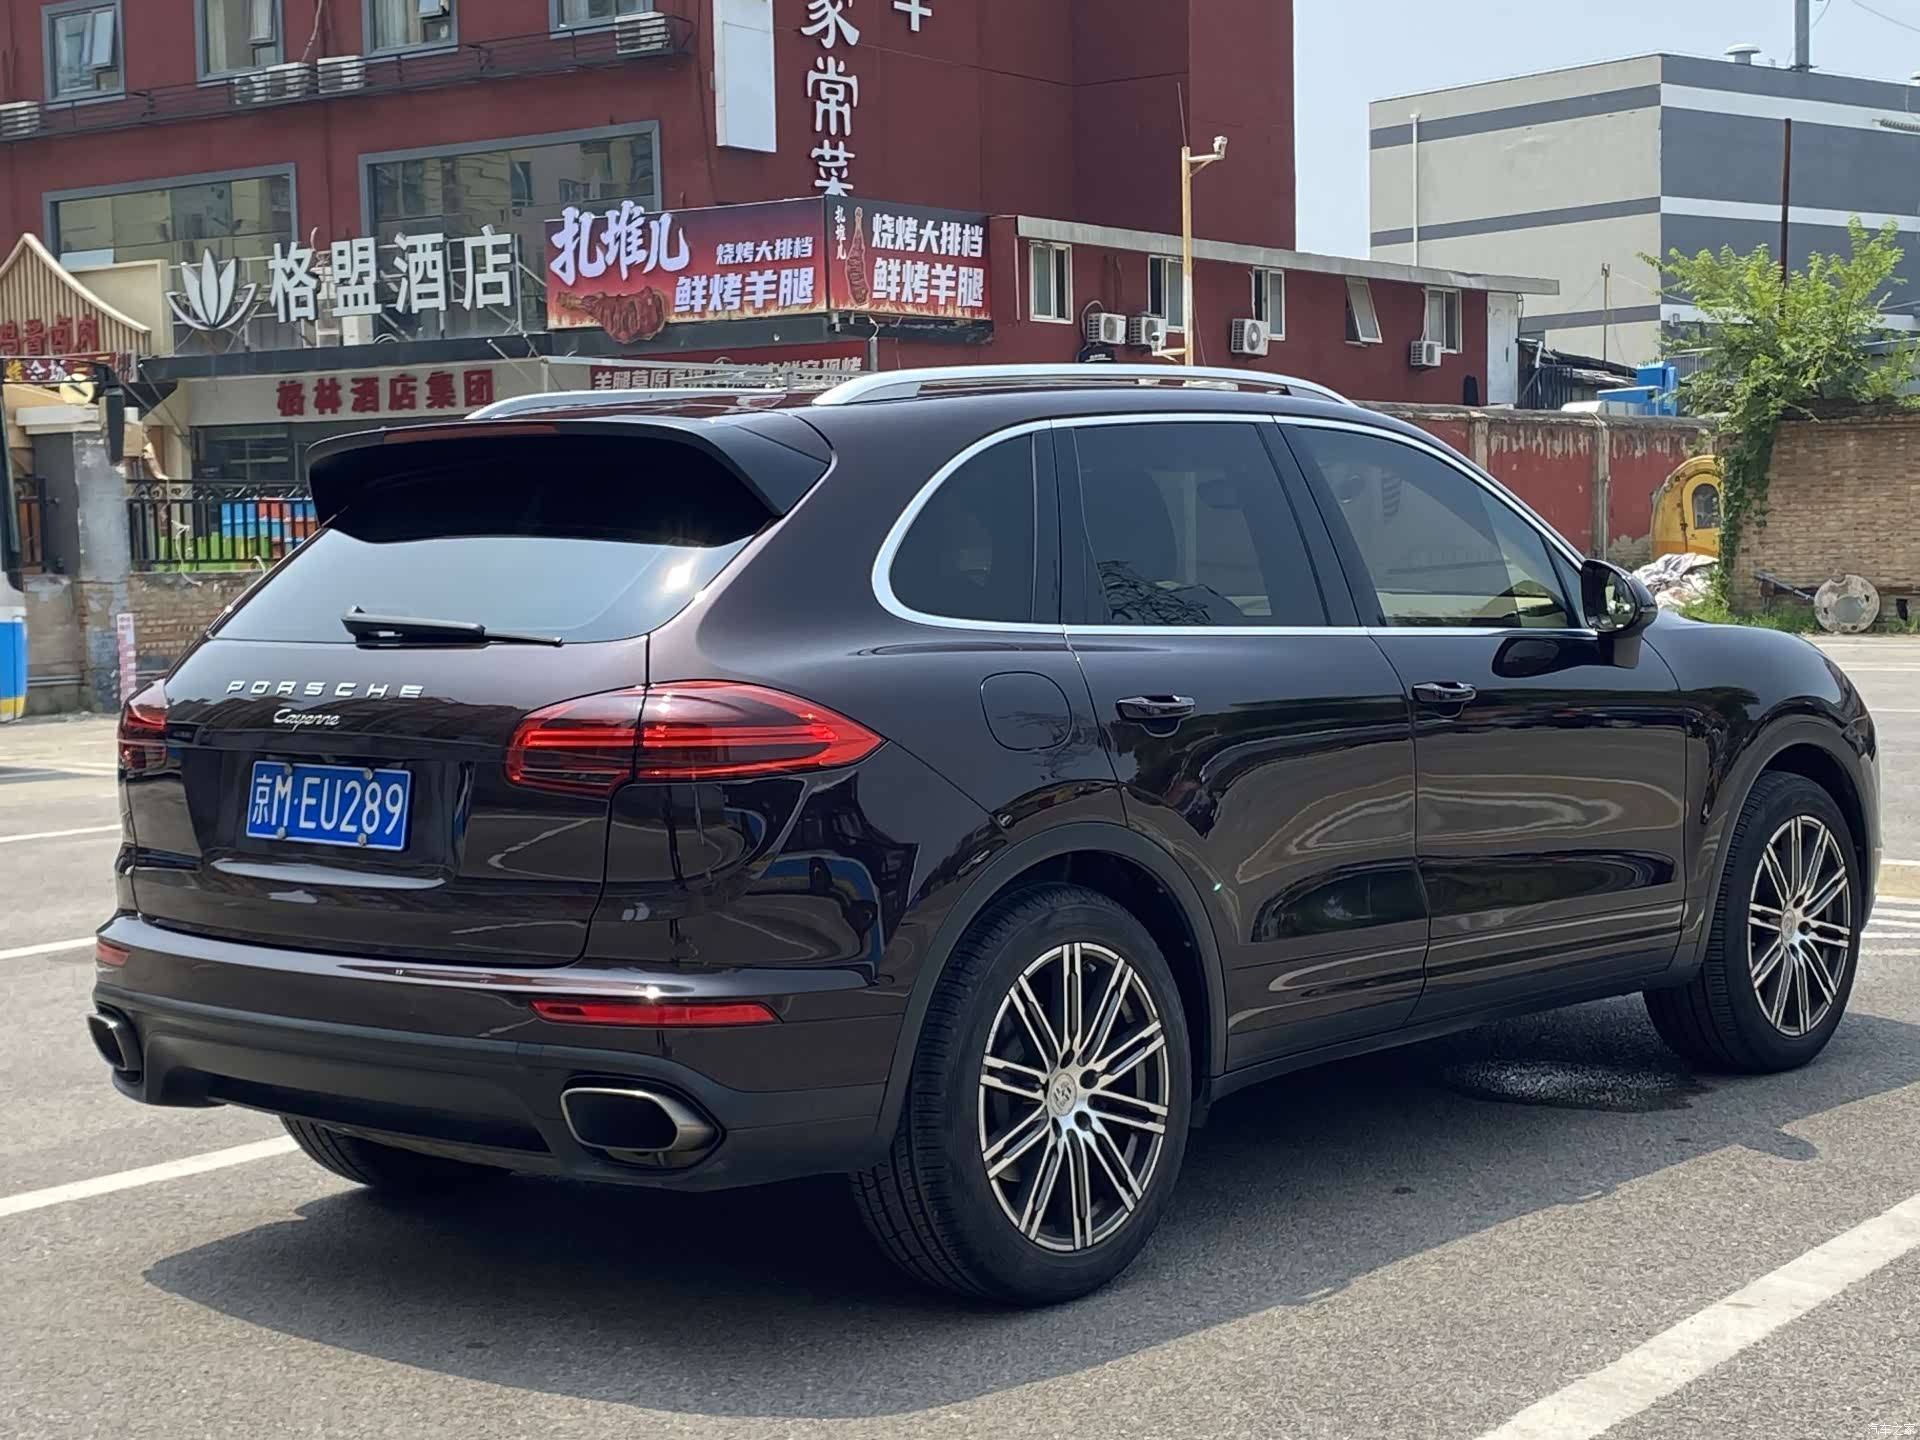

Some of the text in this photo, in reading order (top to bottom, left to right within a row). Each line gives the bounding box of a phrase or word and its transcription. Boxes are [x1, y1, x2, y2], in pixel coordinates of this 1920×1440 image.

[549, 201, 690, 286] 扎堆儿
[715, 236, 814, 266] 烧烤大排档
[834, 204, 847, 261] 扎堆儿
[872, 213, 984, 258] 烧烤大排档
[268, 224, 514, 323] 格盟酒店
[674, 266, 814, 314] 鲜烤羊腿
[872, 257, 985, 309] 鲜烤羊腿
[226, 680, 425, 699] PORSCHE
[273, 708, 341, 732] Cayenne
